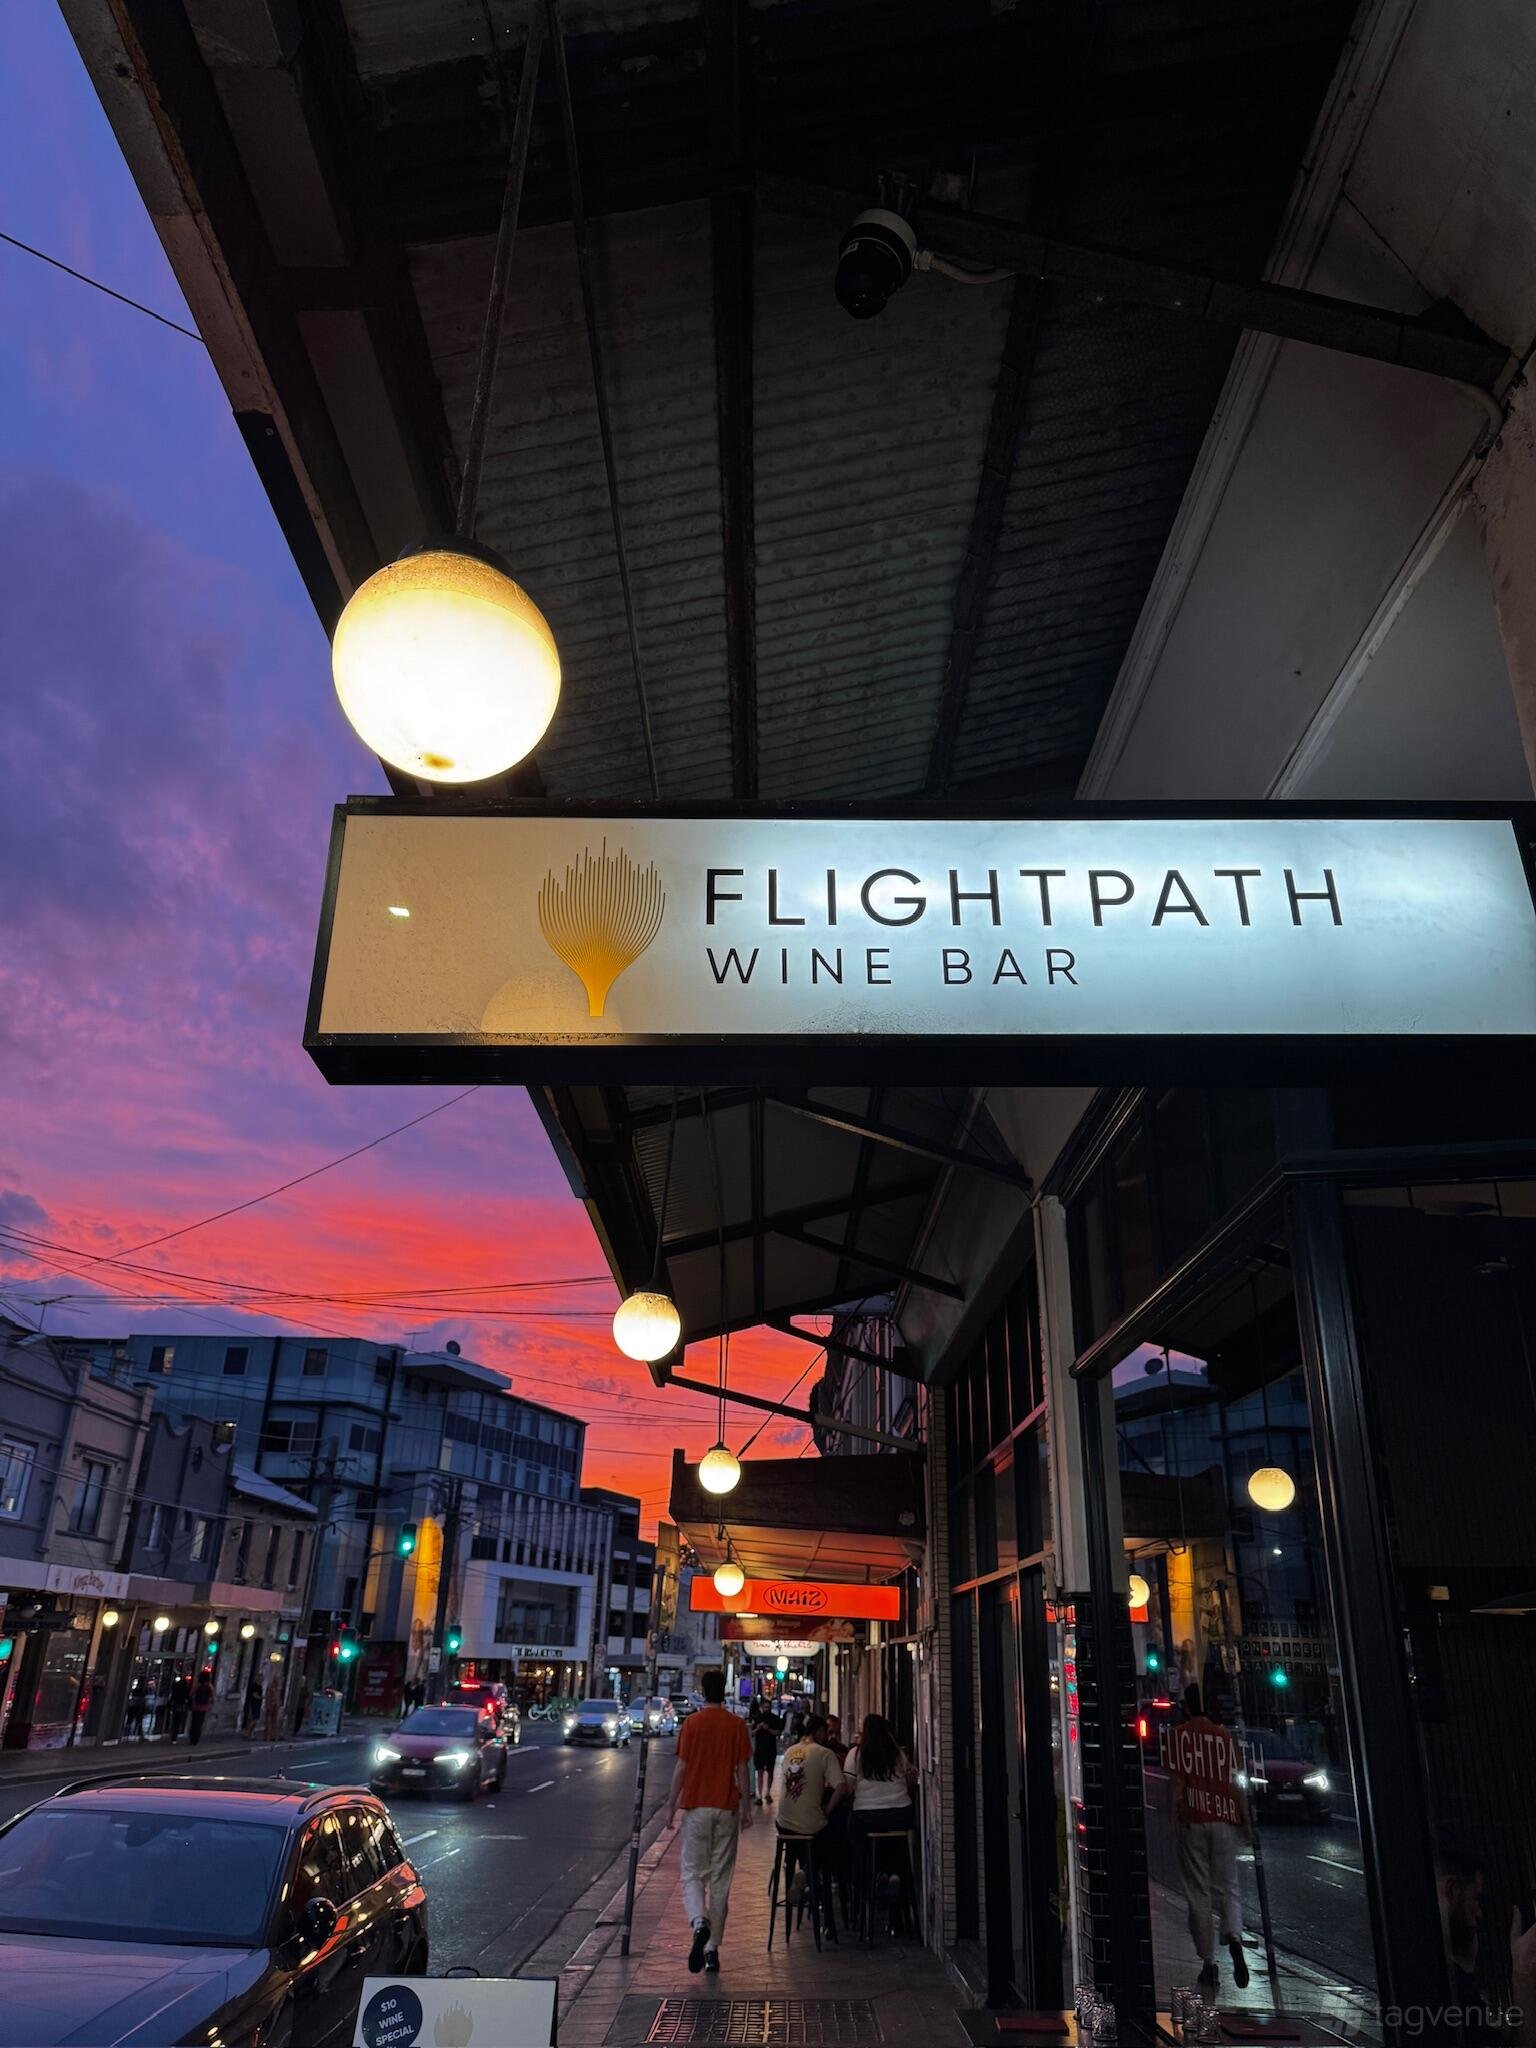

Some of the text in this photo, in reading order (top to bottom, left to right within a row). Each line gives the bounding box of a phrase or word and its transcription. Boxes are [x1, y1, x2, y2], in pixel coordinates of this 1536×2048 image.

[705, 867, 1344, 928] FLIGHTPATH
[705, 947, 1080, 986] WINE BAR
[1159, 1724, 1267, 1793] FLIGHTPATH
[1186, 1786, 1237, 1823] WINE BAR
[378, 2011, 405, 2029] WINE
[380, 1998, 397, 2013] $10
[375, 2024, 415, 2046] SPECIAL
